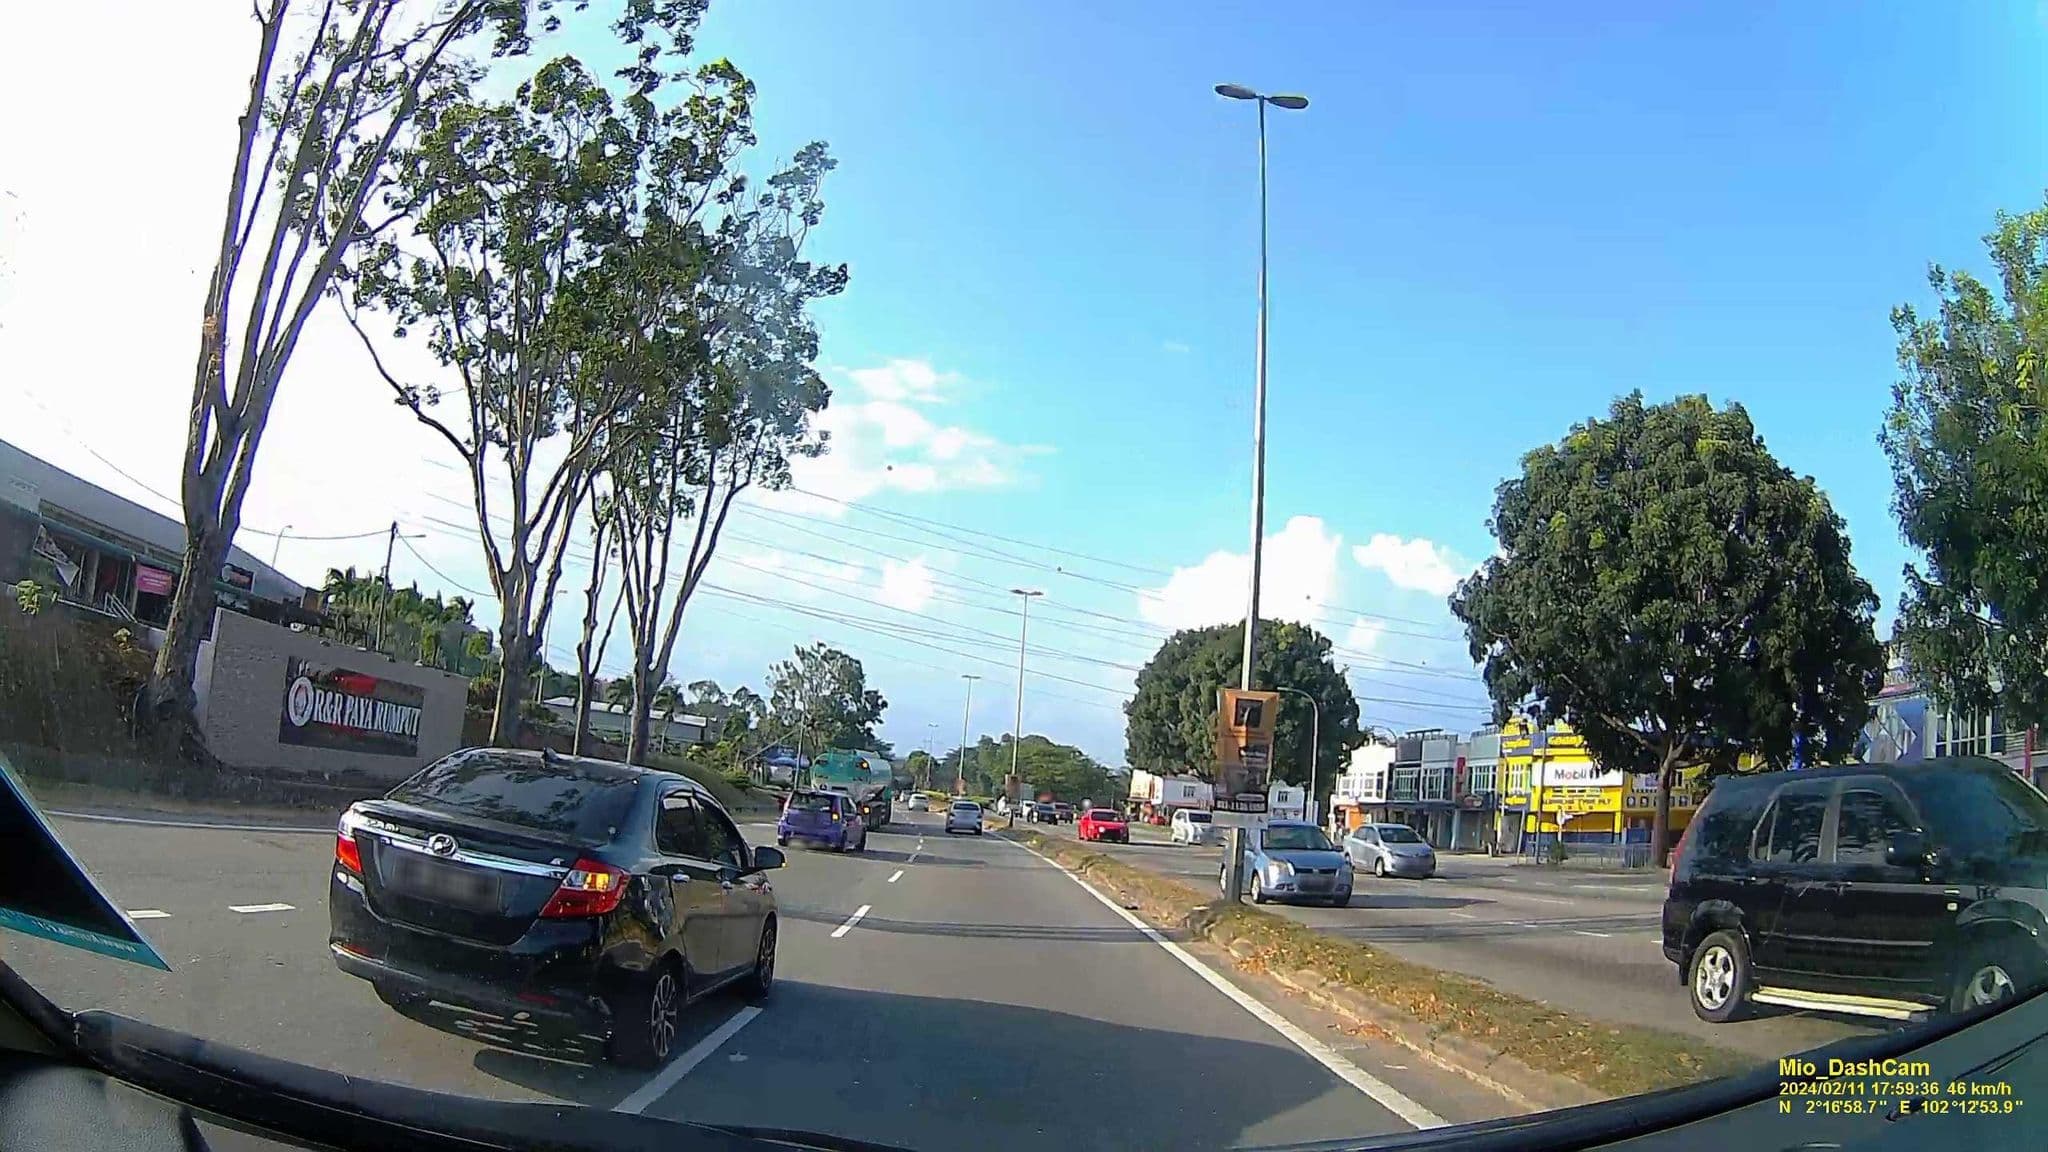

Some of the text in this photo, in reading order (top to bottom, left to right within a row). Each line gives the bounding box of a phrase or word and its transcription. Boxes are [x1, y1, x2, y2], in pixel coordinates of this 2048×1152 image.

[314, 690, 422, 736] R&R PAYA RUMPUT
